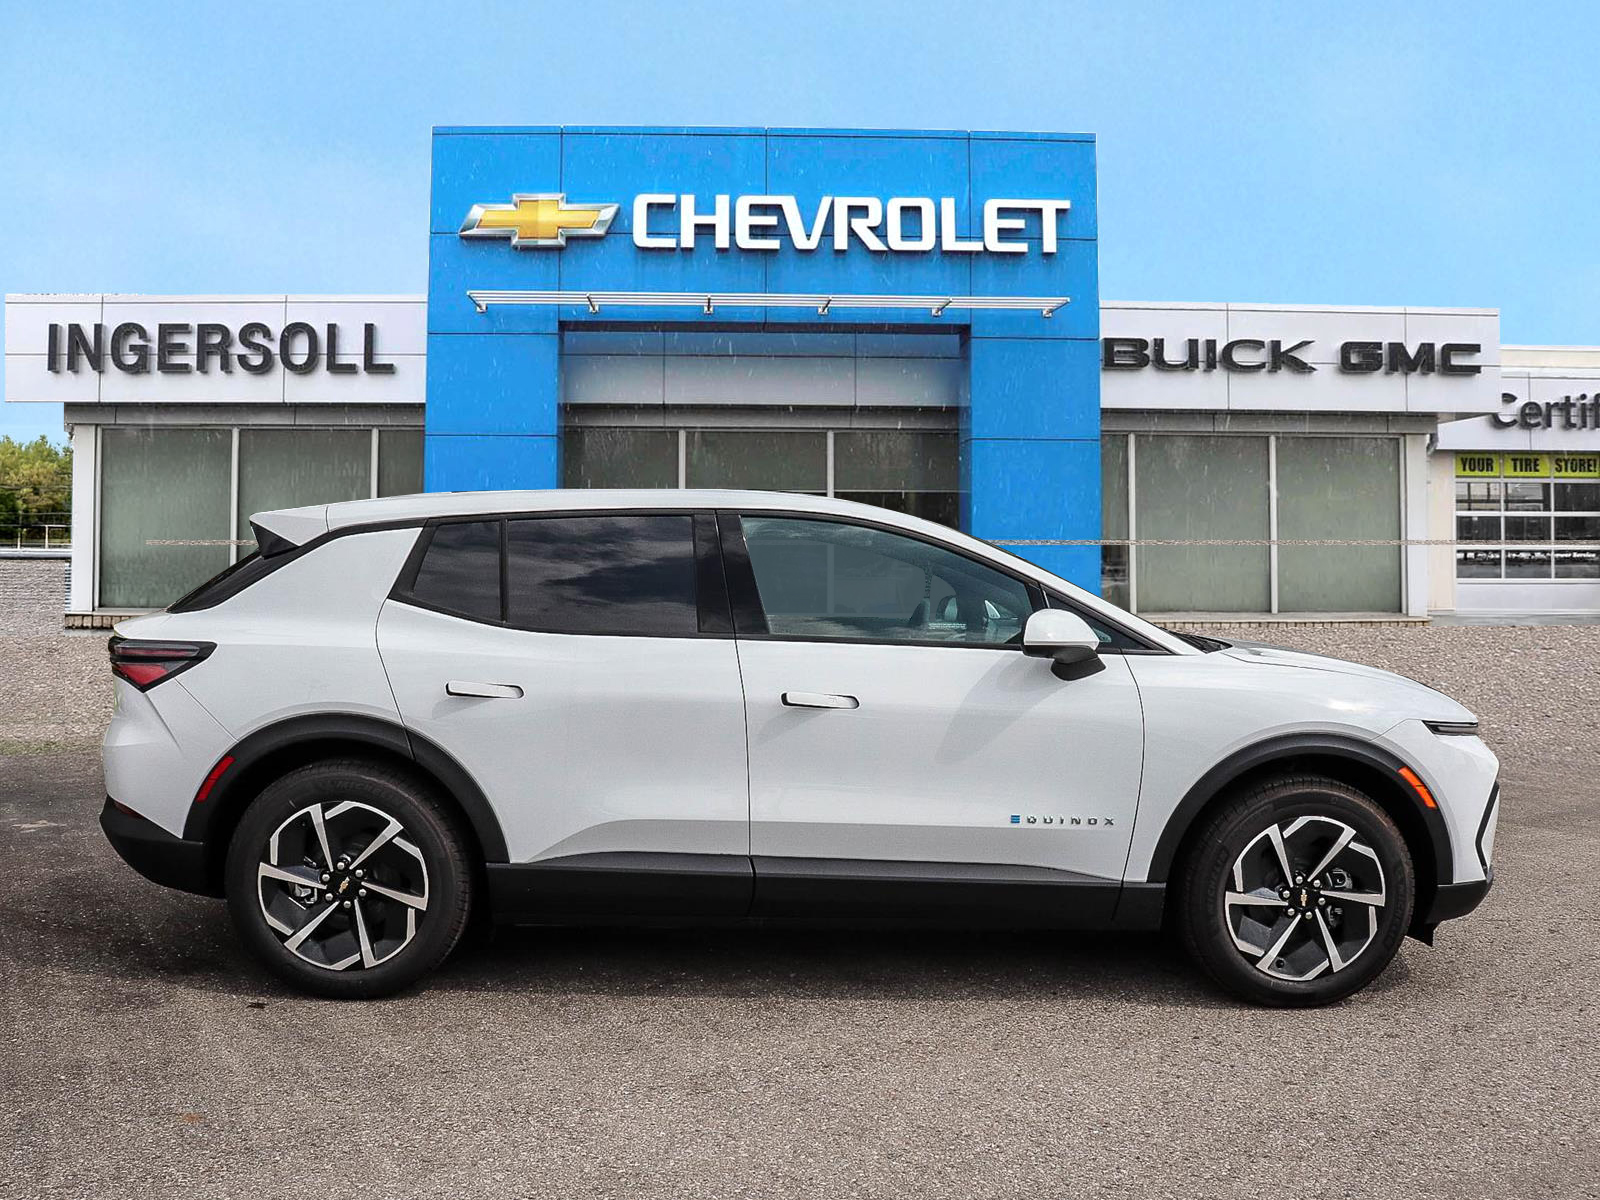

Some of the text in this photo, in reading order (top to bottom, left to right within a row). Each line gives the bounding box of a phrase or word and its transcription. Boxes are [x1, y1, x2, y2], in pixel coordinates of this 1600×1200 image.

[632, 193, 1071, 254] CHEVROLET
[47, 322, 396, 375] INGERSOLL
[1102, 337, 1482, 375] BUICK GMC
[1460, 457, 1597, 473] YOUR TIRE STORE!
[1010, 814, 1114, 826] EQUINOX
